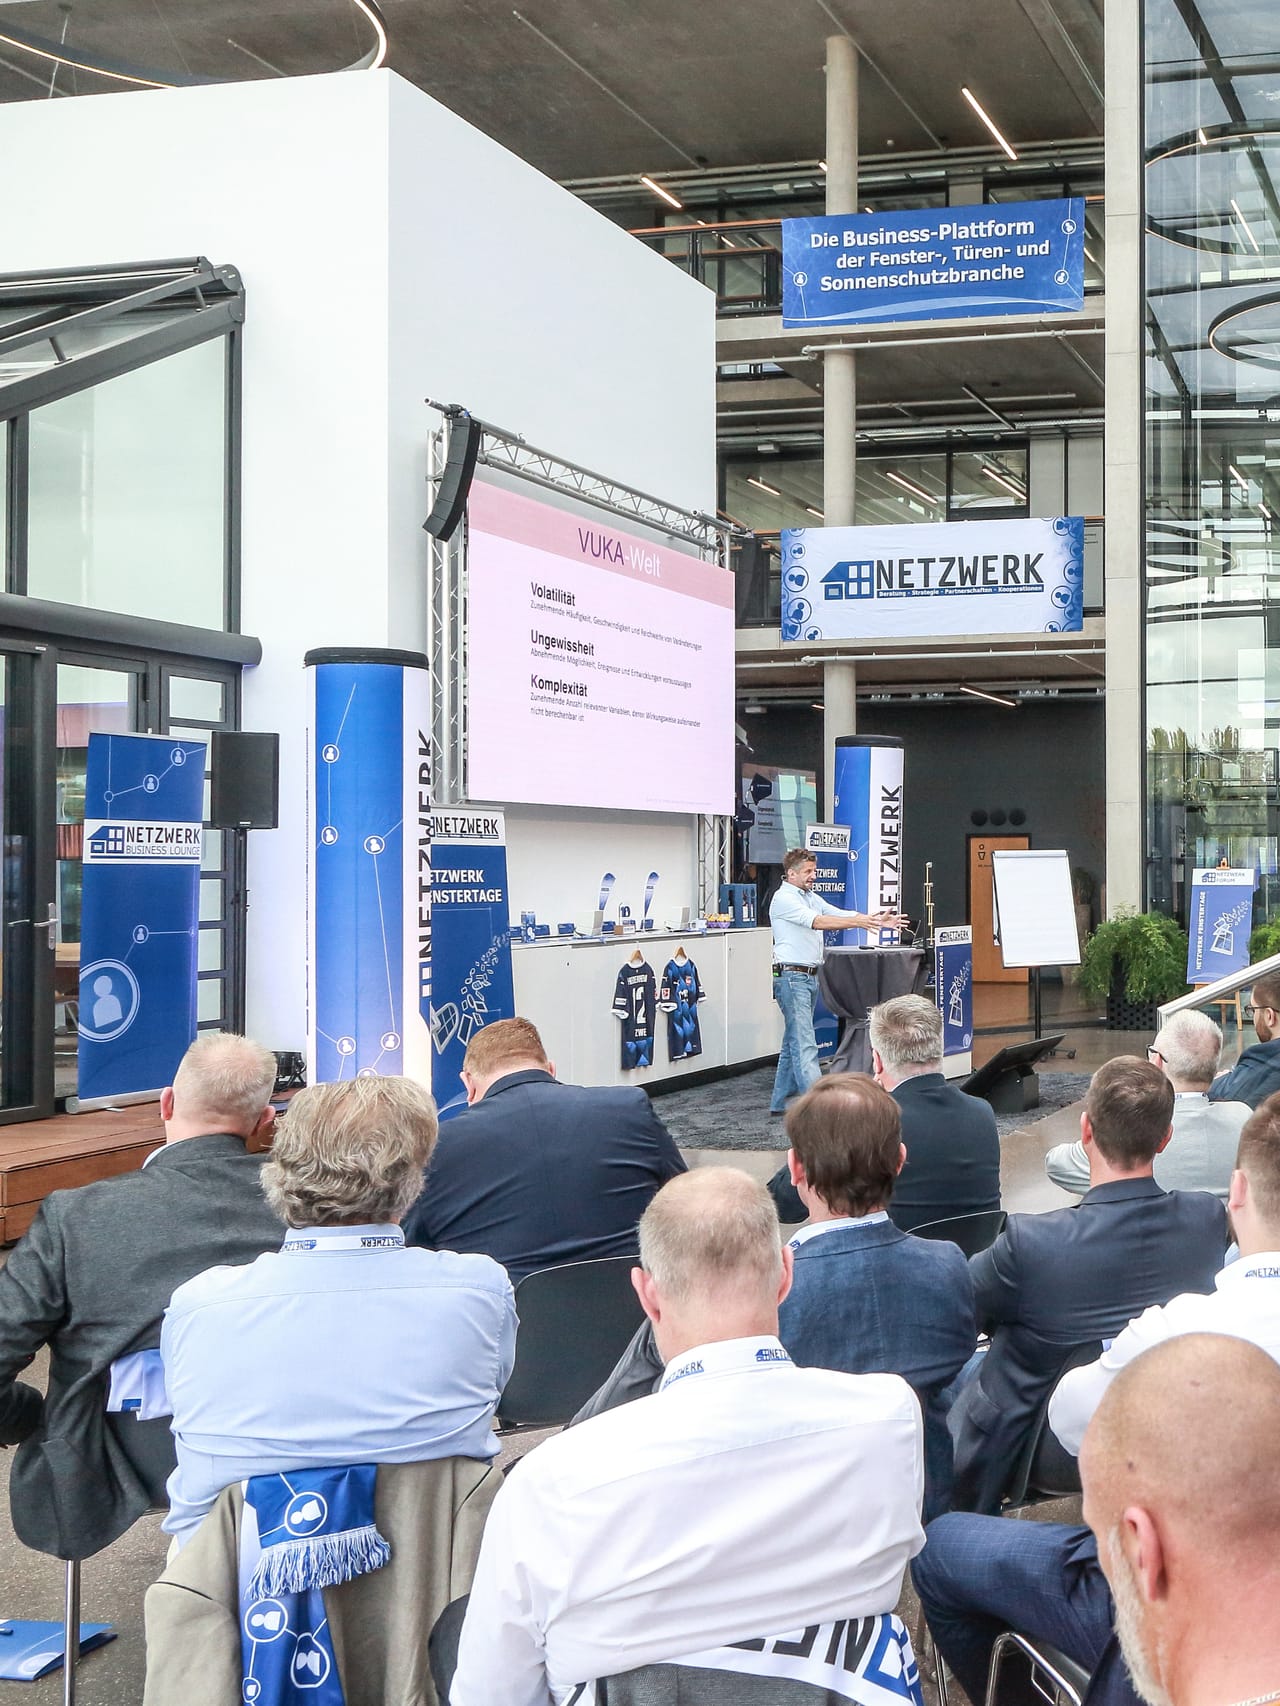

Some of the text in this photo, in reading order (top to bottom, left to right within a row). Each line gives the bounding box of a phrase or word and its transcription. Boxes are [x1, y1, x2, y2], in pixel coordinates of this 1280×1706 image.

[810, 219, 1035, 249] Die Business-Plattform
[836, 239, 1050, 269] der Fenster-, Türen- und
[820, 264, 1025, 292] Sonnenschutzbranche
[578, 527, 661, 578] VUKA-Welt
[876, 553, 1045, 590] NETZWERK
[531, 582, 576, 607] Volatilität
[530, 600, 565, 617] Zunehmende
[530, 647, 566, 662] Abnehmende
[531, 629, 595, 657] Ungewissheit
[530, 674, 588, 697] Komplexität
[530, 692, 566, 706] Zunehmende
[126, 827, 200, 844] NETZWERK
[436, 816, 499, 834] NETZWERK
[126, 845, 200, 856] BUSINESS LOUNGE
[880, 784, 903, 917] ETZWERK
[431, 888, 503, 903] NSTERTAGE
[812, 882, 845, 892] ENSTERTAGE
